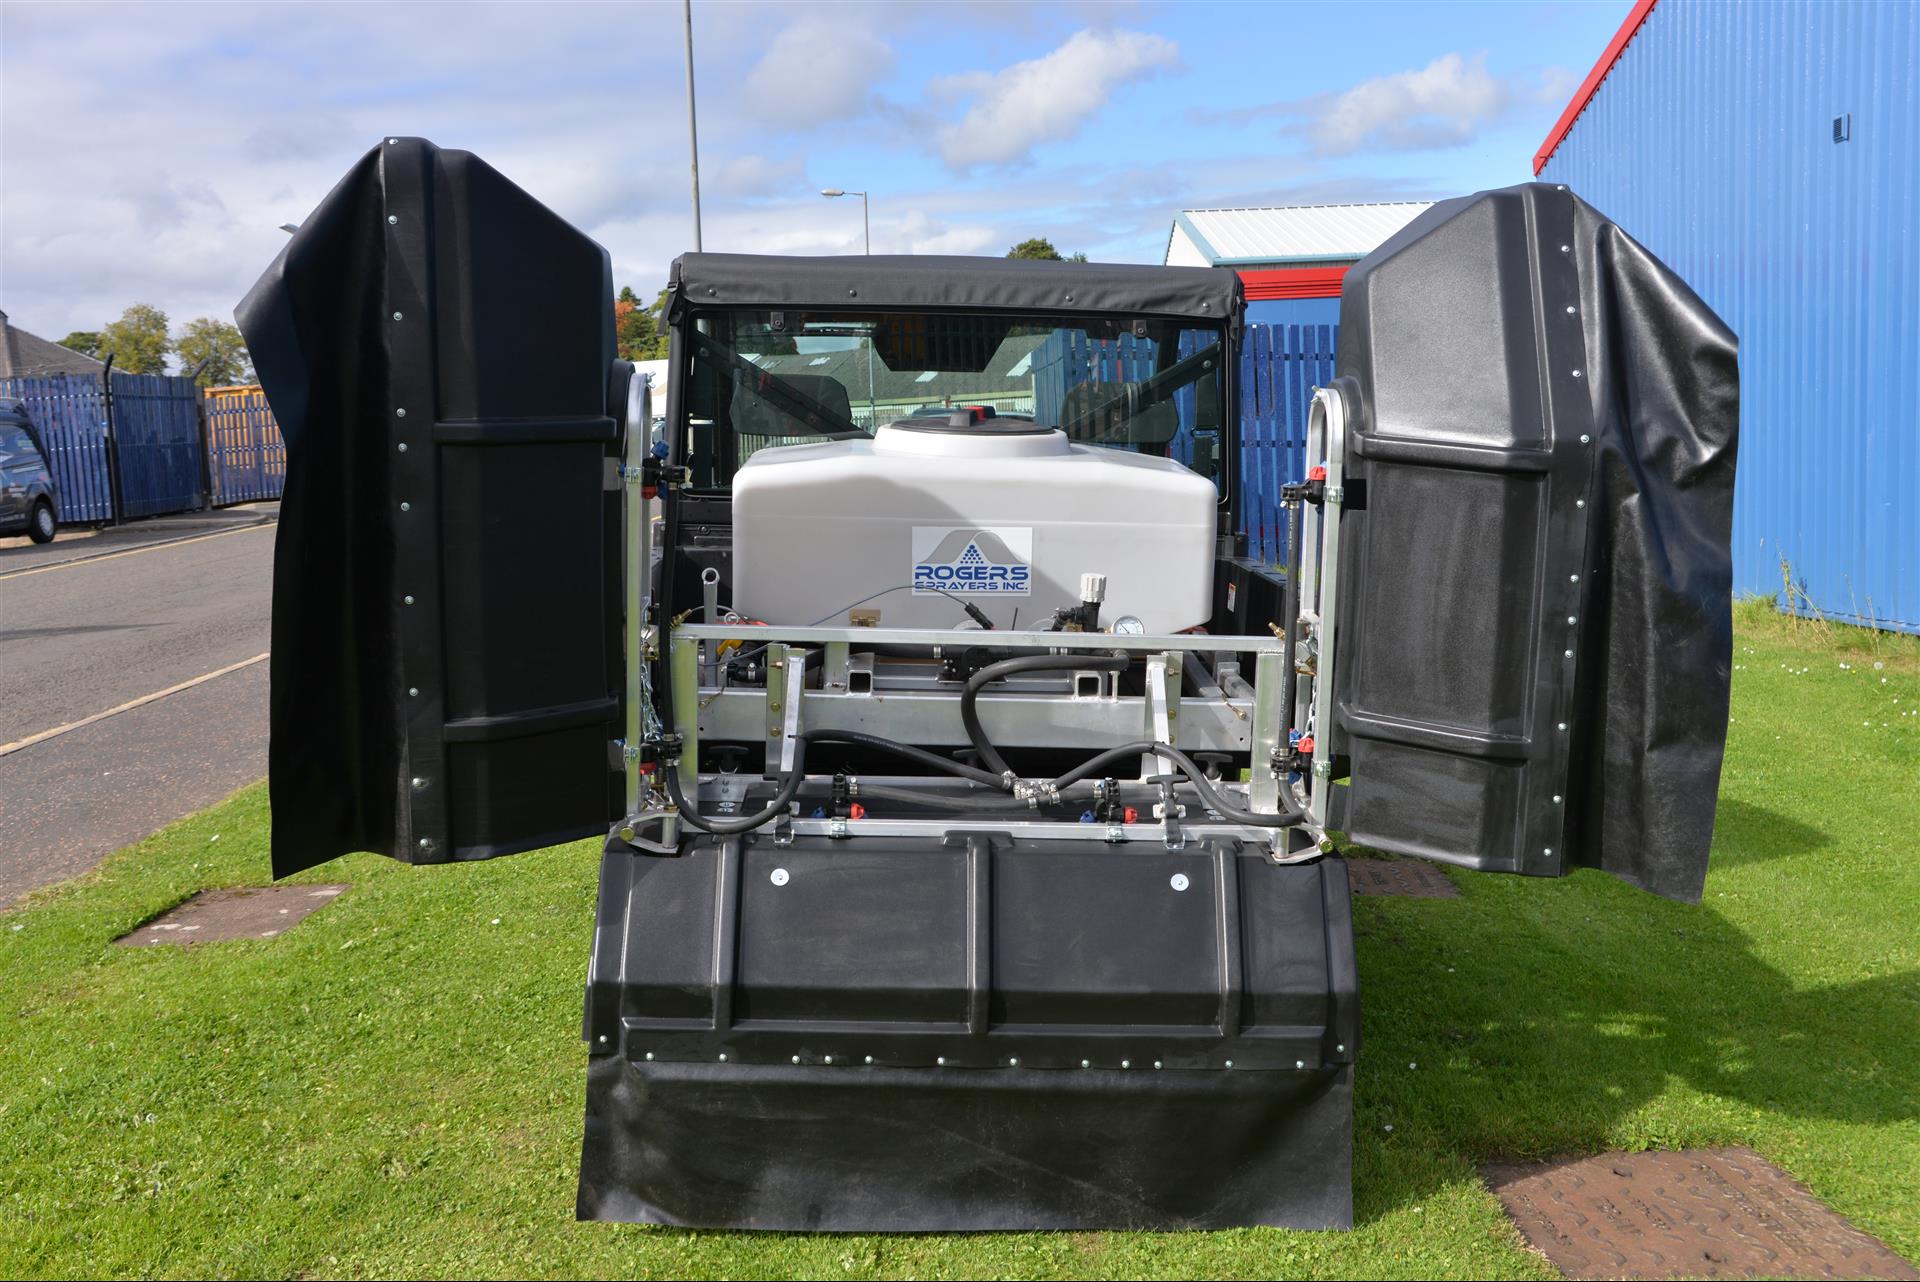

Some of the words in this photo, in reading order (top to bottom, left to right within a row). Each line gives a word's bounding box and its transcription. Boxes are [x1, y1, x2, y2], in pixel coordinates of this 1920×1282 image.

[915, 566, 1029, 580] ROGERS
[915, 581, 998, 590] SPRAYERS
[1003, 582, 1028, 590] INC.
